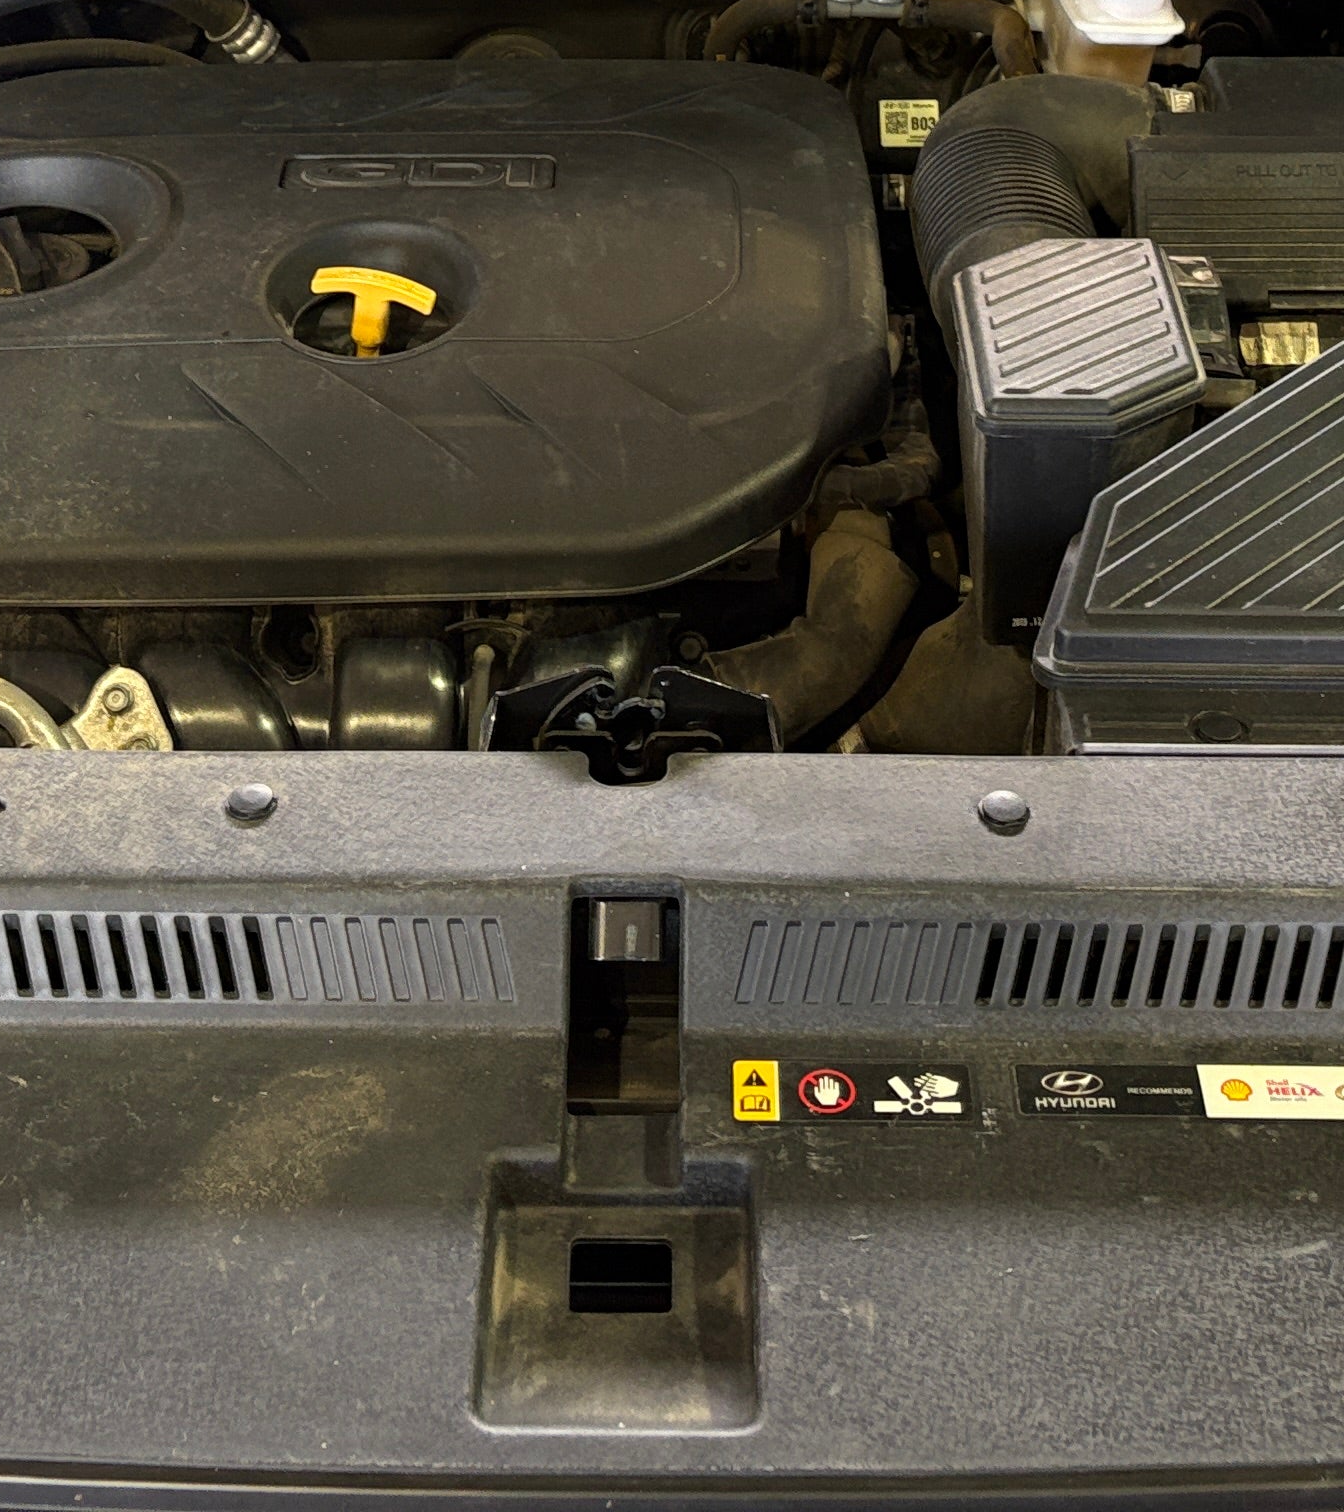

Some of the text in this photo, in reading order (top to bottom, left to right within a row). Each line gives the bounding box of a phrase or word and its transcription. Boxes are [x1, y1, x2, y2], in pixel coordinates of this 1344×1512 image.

[299, 159, 536, 189] GDI
[1126, 1086, 1194, 1095] RECOMMENDS
[1266, 1086, 1323, 1097] HELIX
[1034, 1096, 1117, 1110] HYUNDAI
